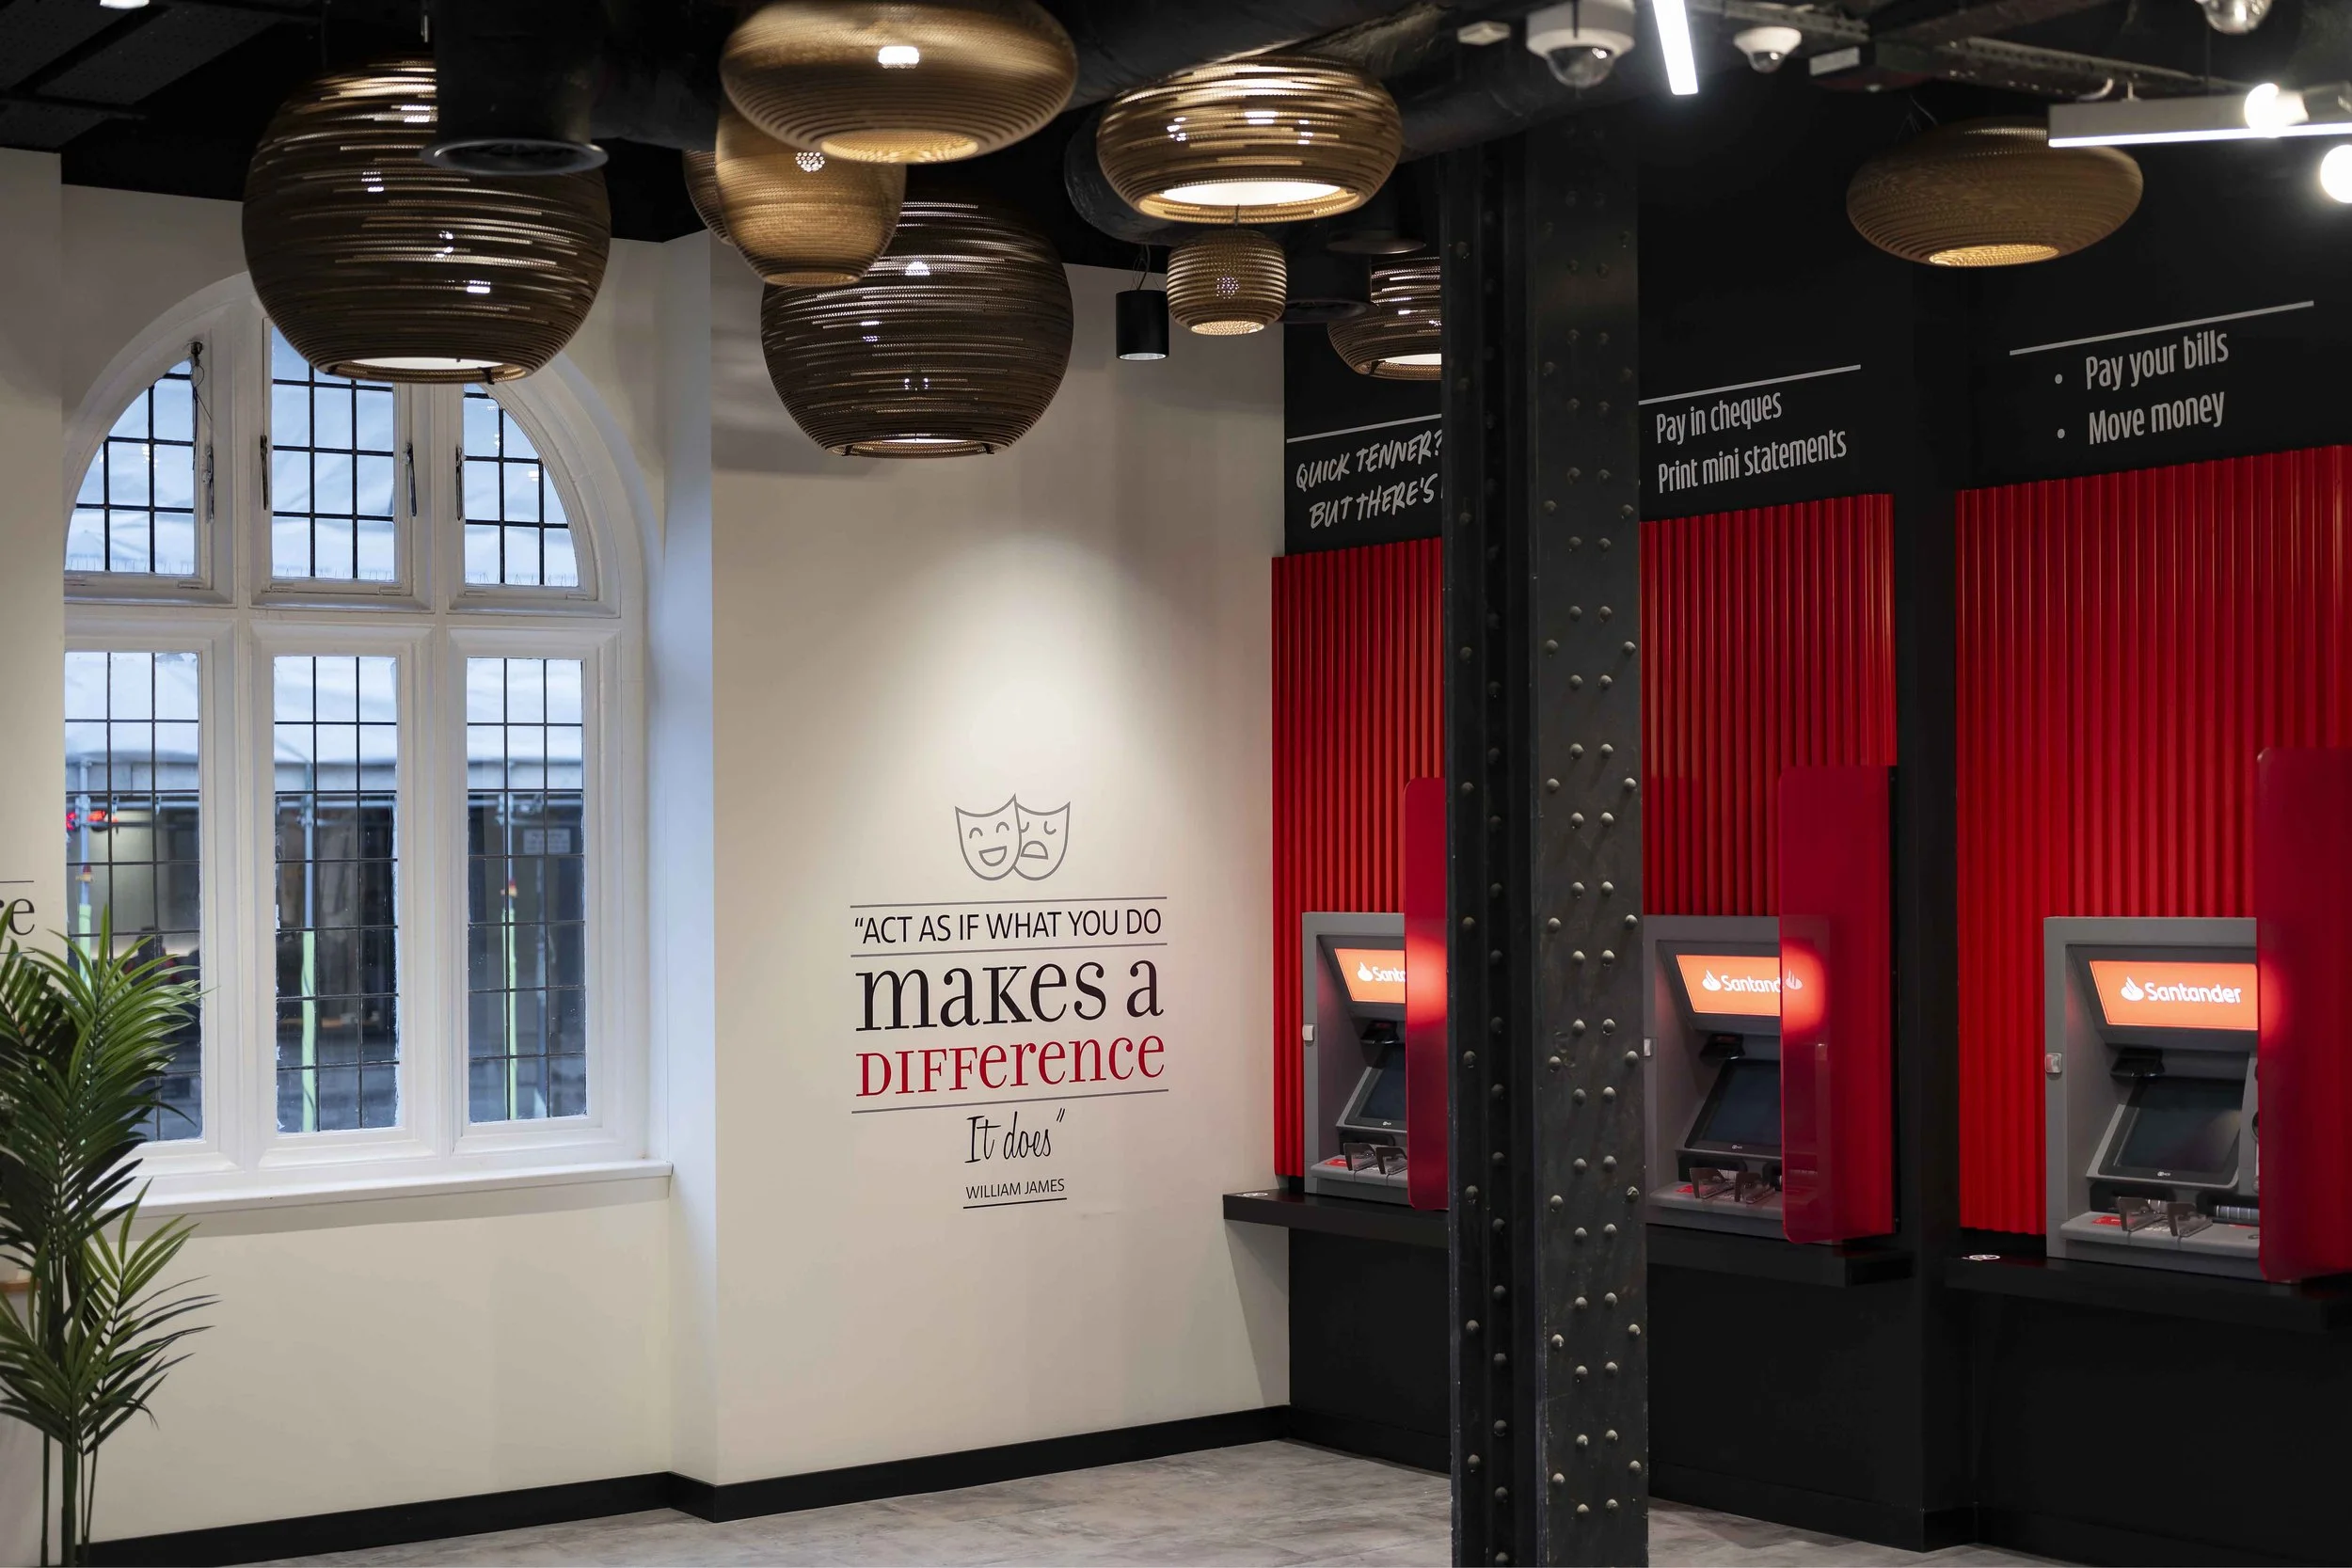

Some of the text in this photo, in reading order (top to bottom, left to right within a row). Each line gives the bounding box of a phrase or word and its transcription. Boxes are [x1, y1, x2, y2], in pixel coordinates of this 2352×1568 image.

[2085, 329, 2229, 391] Pay your bills
[1656, 391, 1783, 446] Pay in cheques
[2089, 391, 2225, 445] Move money
[1295, 429, 1443, 493] QUICK TENNER?
[1658, 429, 1848, 494] Print mini statements
[1309, 472, 1439, 530] BUT THERE'S
[854, 908, 1162, 944] “ACT AS IF WHAT YOU DO
[1126, 959, 1165, 1018] a
[2144, 982, 2242, 1004] Santander
[963, 1116, 1002, 1164] It
[965, 1178, 1065, 1200] WILLIAM JAMES
